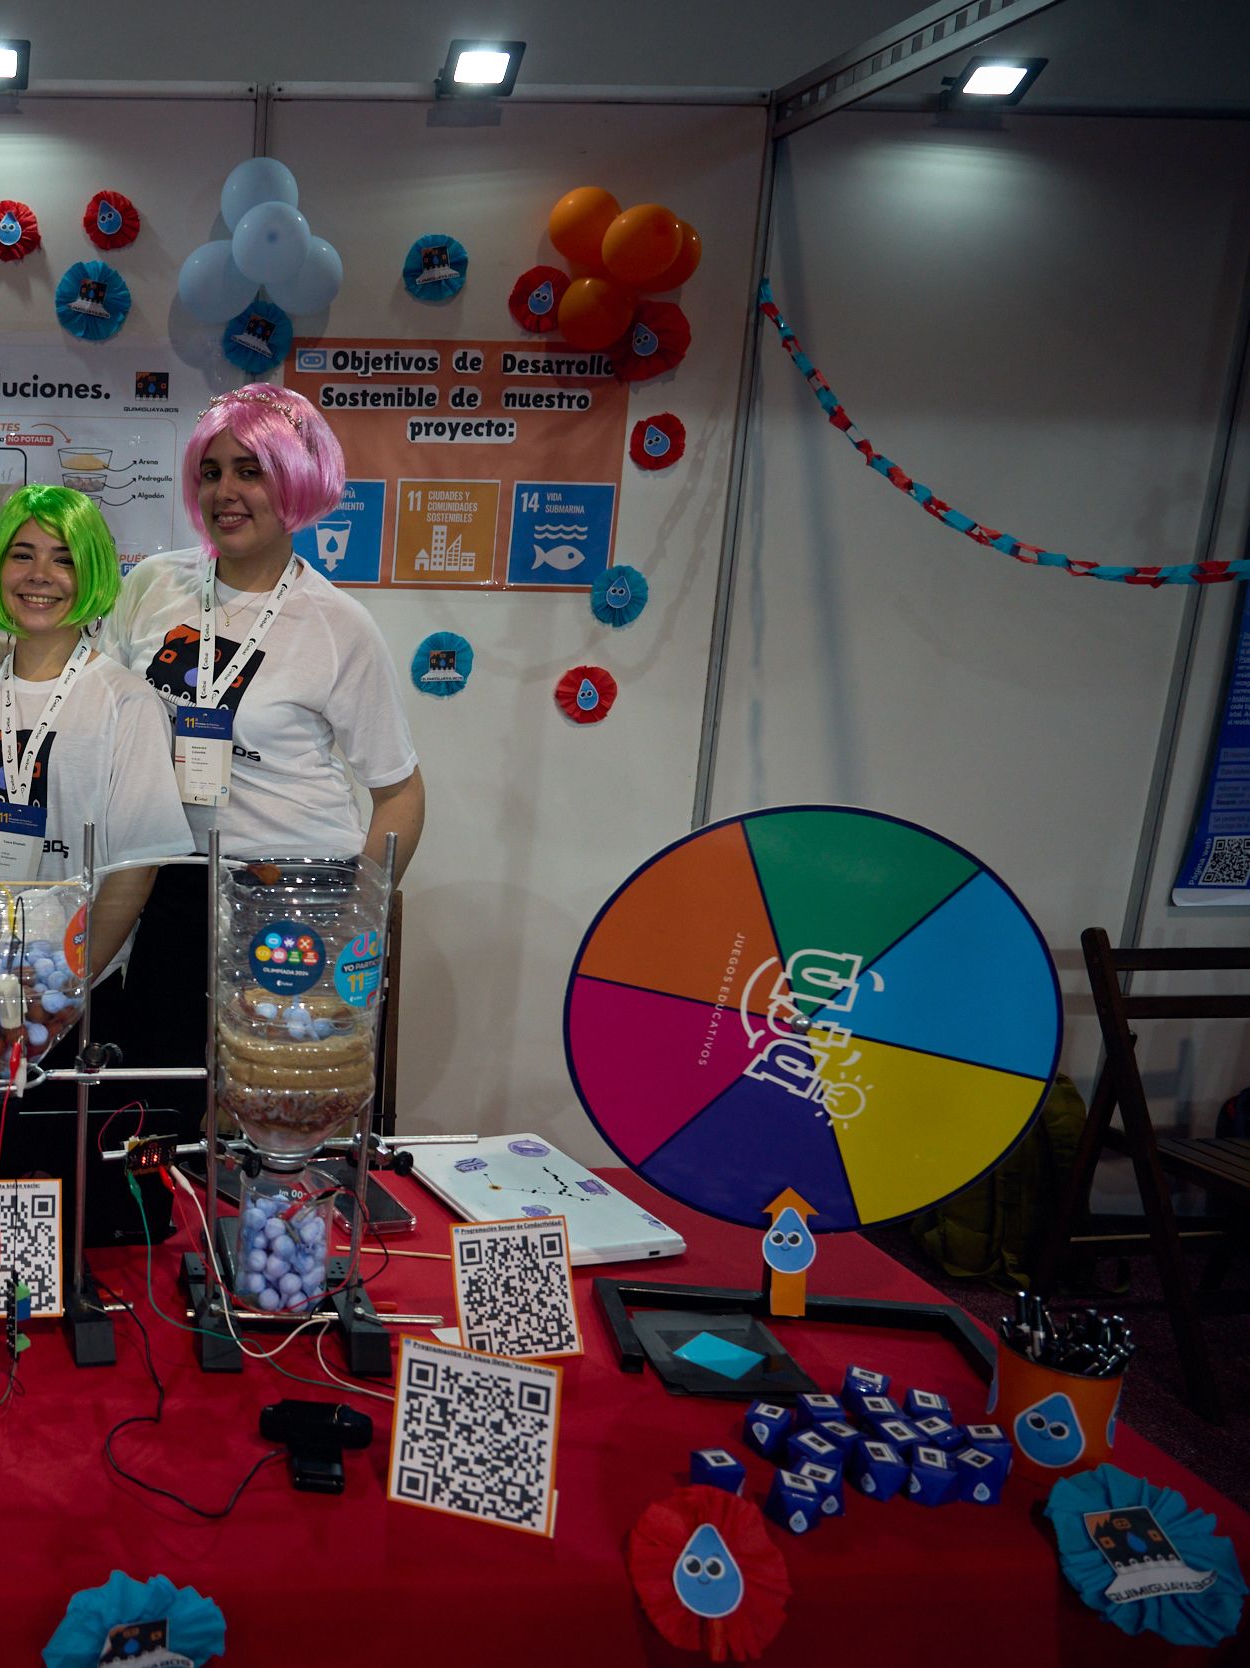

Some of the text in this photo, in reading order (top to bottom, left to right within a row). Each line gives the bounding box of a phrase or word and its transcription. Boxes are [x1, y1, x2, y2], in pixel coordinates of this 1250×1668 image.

[333, 351, 438, 375] Objetivos
[454, 351, 482, 371] de
[322, 387, 589, 409] Sostenible de nuestro
[21, 436, 51, 444] POTABLE
[410, 420, 515, 441] proyecto:
[407, 490, 470, 512] 11 CIUDADES Y
[427, 502, 478, 512] COMUNIDADES
[520, 491, 562, 514] 14 VIDA
[545, 504, 585, 515] SUBMARINA
[426, 512, 473, 524] SOSTENIBLES
[698, 932, 745, 1066] JUEGOS EDUCATIVOS
